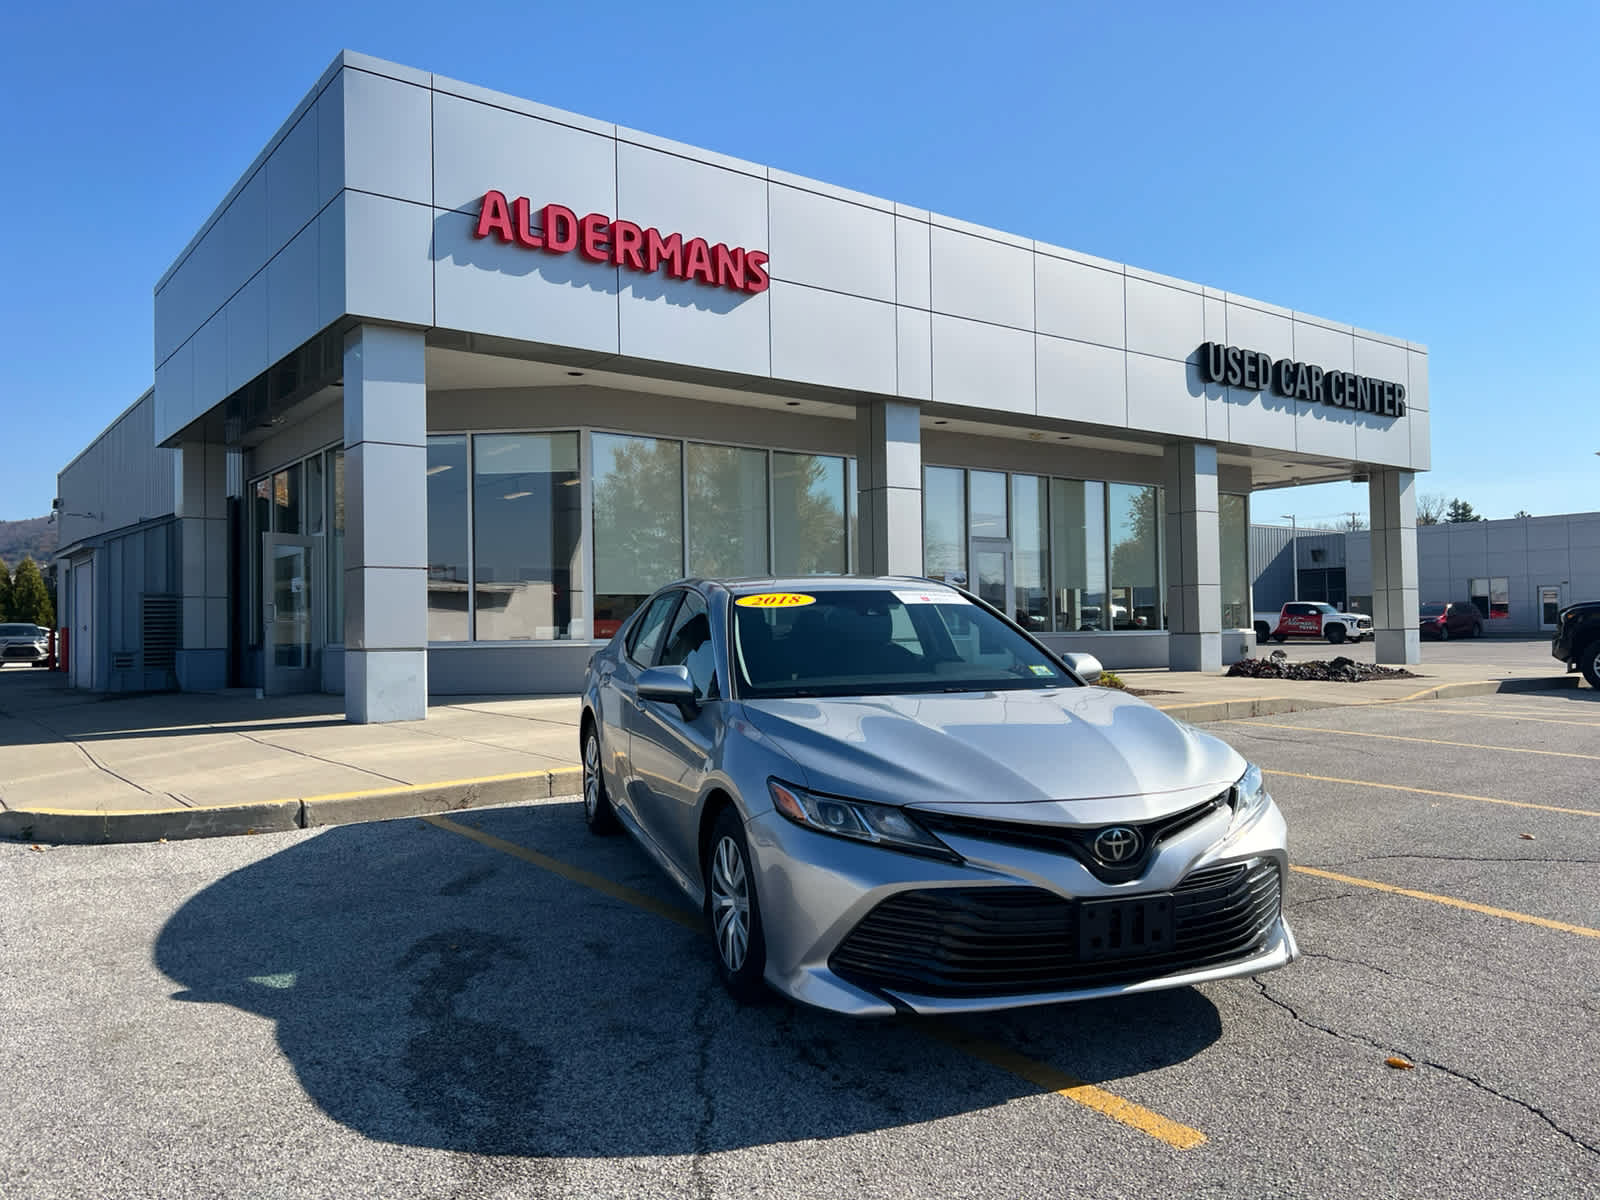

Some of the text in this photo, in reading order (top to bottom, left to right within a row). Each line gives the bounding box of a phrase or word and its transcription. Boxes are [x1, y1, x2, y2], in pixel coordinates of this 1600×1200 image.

[475, 190, 769, 292] ALDERMANS
[1201, 341, 1406, 417] USED CAR CENTER
[752, 596, 801, 606] 2018
